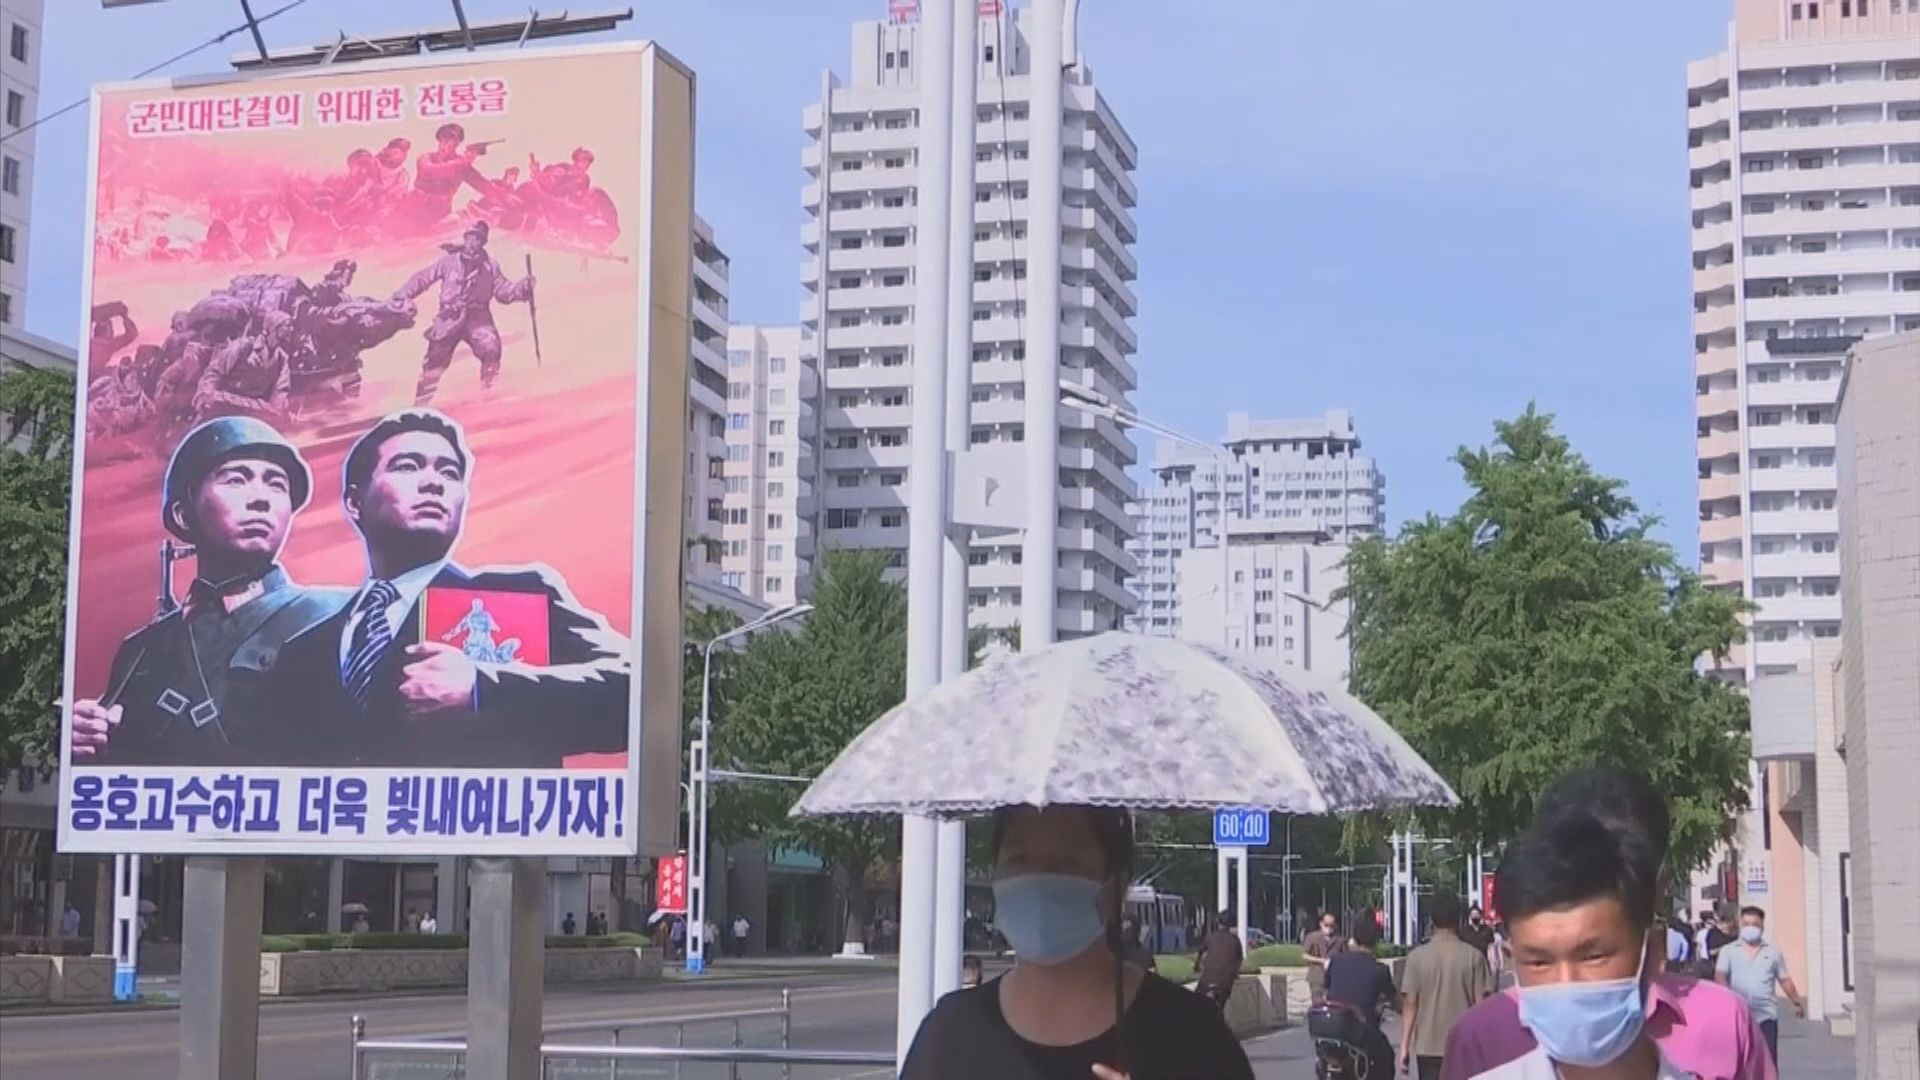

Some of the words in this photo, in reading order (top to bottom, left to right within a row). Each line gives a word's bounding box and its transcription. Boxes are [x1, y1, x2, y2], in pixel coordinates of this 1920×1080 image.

[130, 93, 301, 134] 군민대단결의
[316, 88, 403, 124] 위대한
[71, 774, 280, 833] 옹호고수하고
[298, 776, 368, 834] 더욱
[386, 776, 624, 837] 빛내여나가자!
